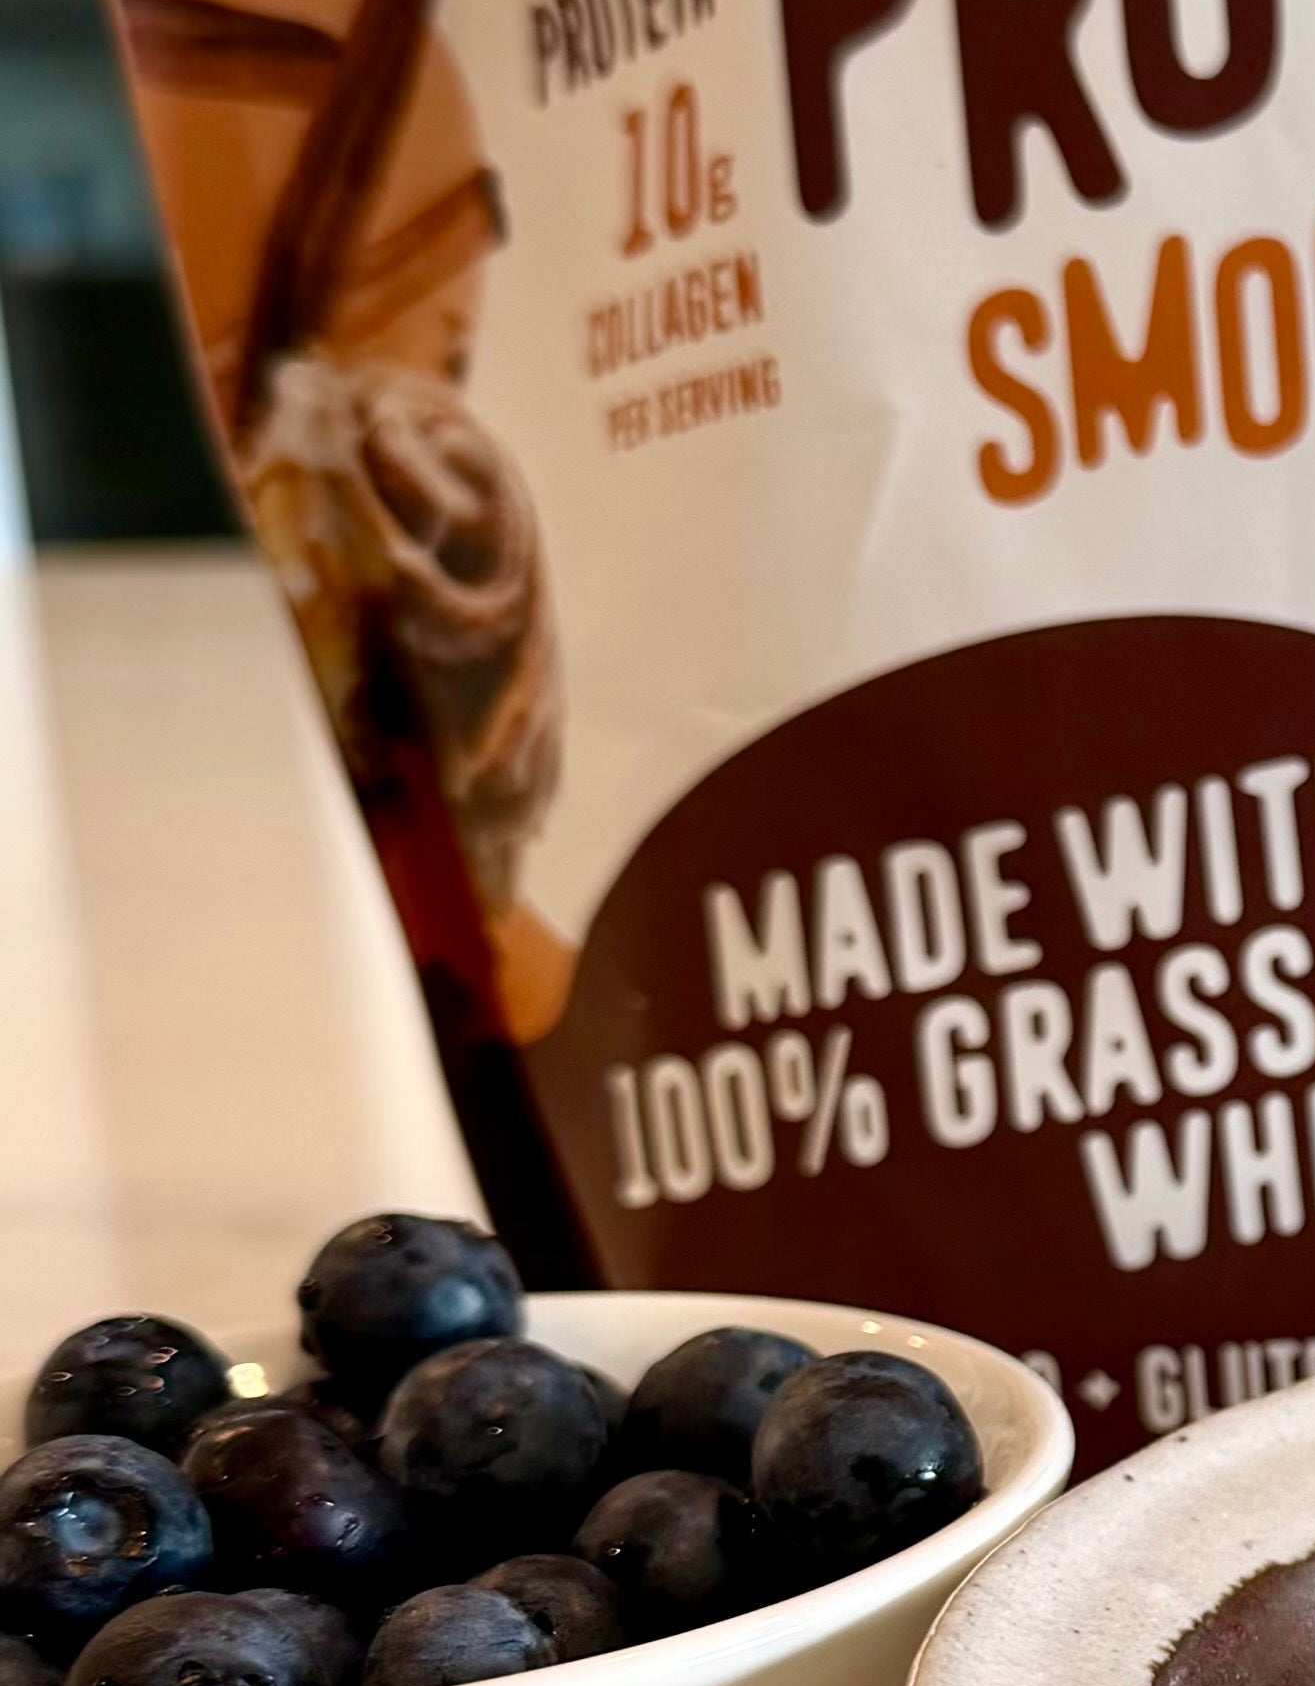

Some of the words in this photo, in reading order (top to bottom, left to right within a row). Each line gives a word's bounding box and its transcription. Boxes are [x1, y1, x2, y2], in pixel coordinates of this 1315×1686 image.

[618, 81, 738, 261] 10g
[586, 248, 765, 381] COLLAGEN
[656, 352, 783, 438] SERVING
[706, 819, 1044, 1031] MADE
[605, 1023, 891, 1210] 100%
